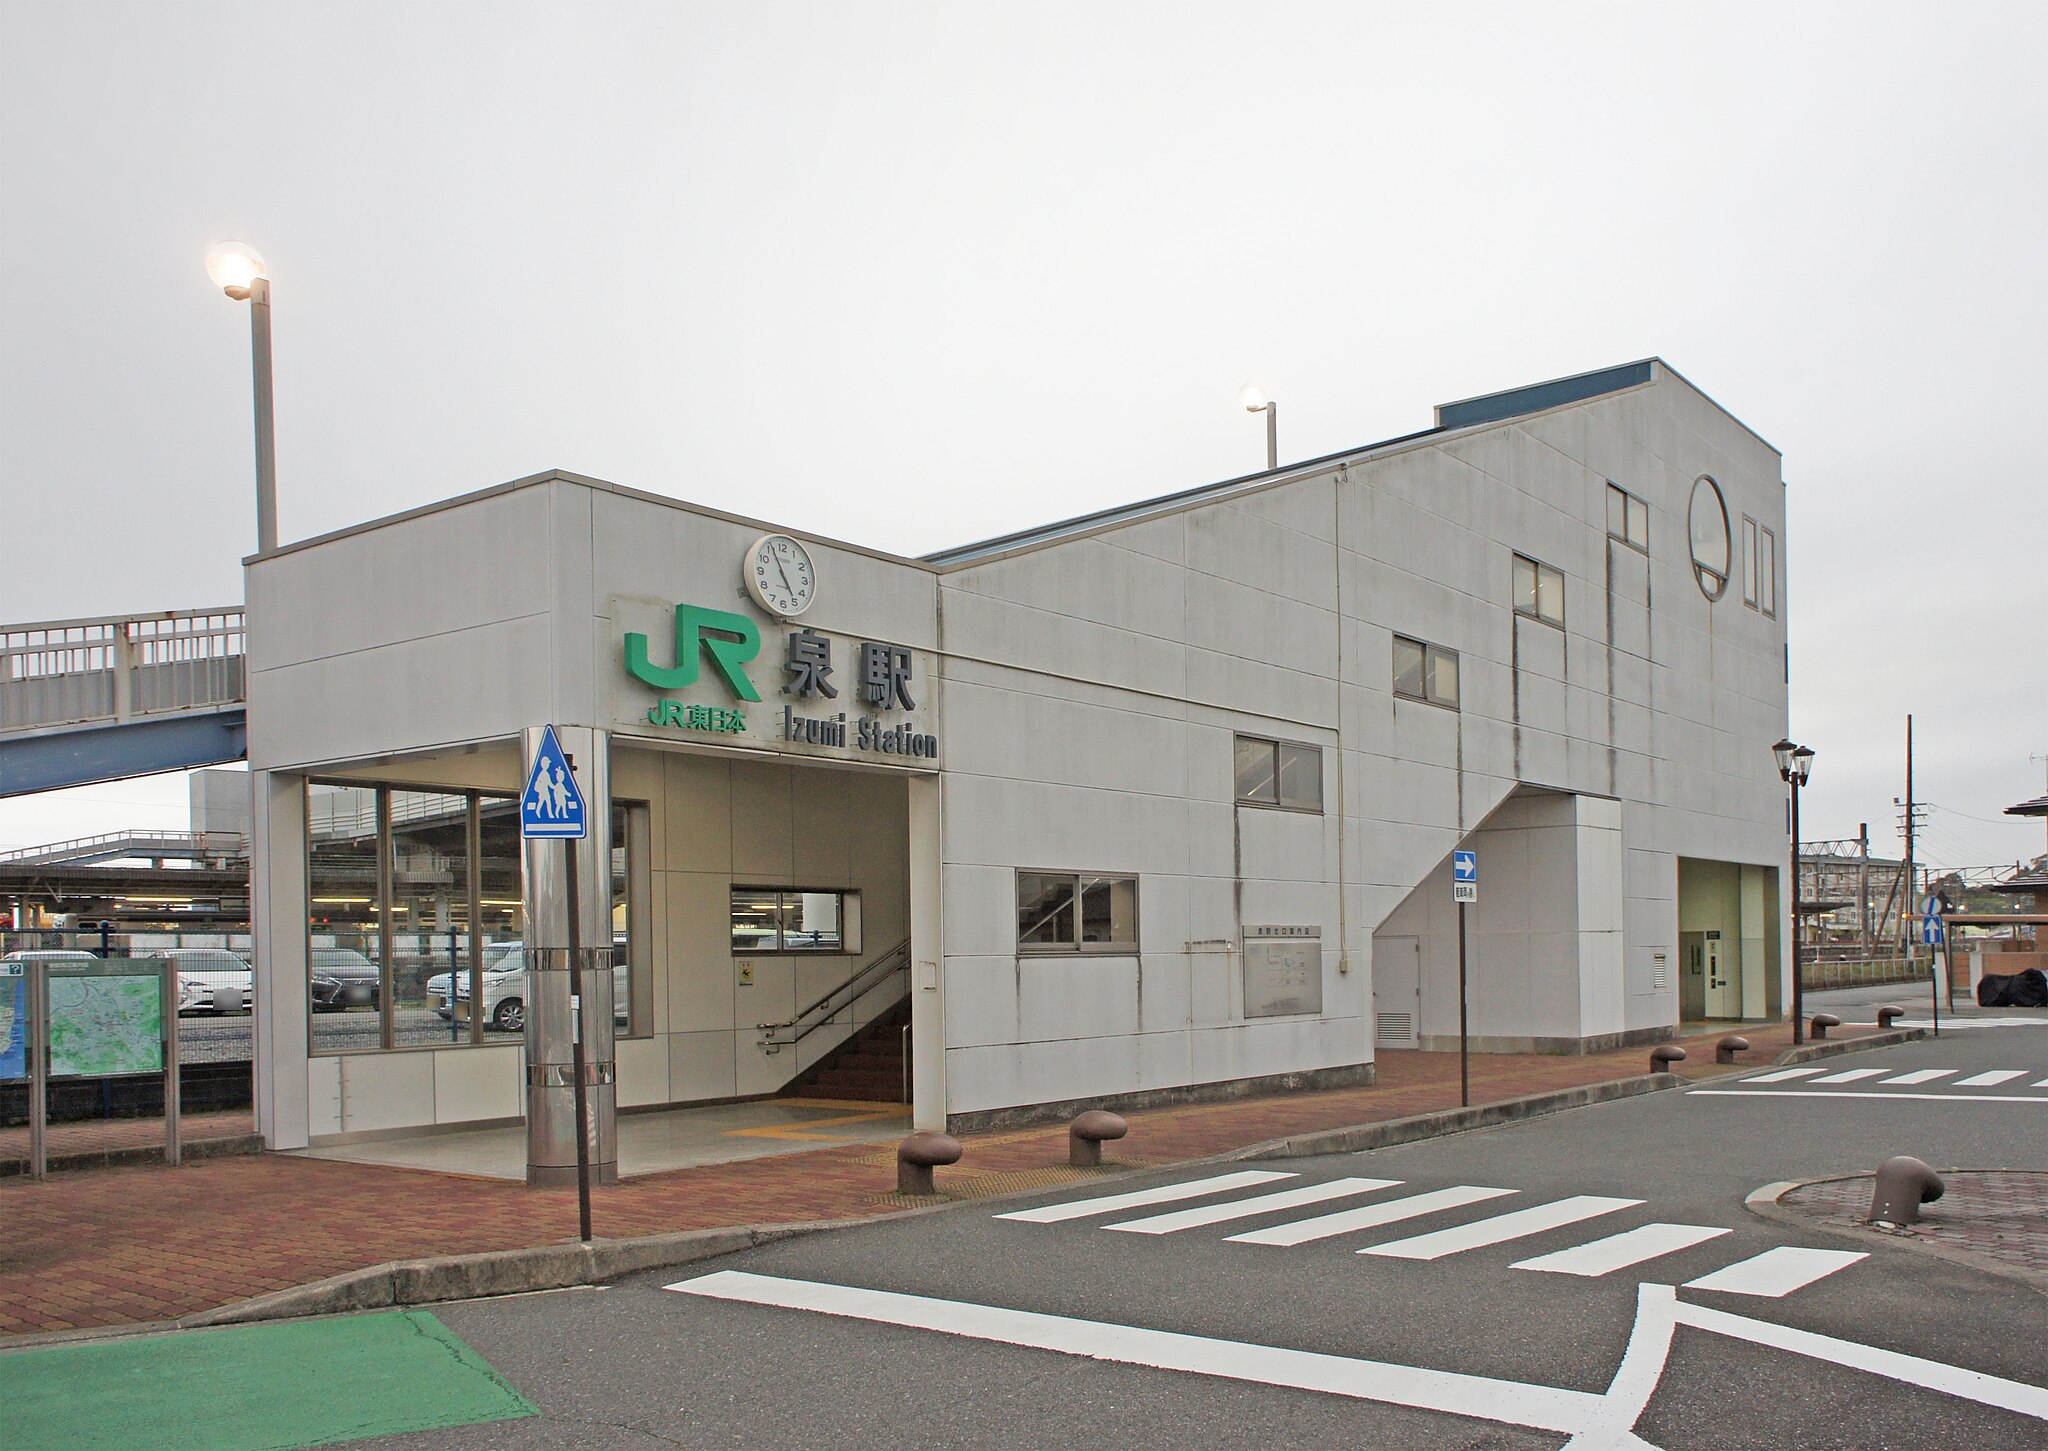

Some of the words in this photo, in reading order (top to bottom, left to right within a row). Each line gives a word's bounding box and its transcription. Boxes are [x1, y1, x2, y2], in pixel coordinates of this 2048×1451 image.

[778, 543, 787, 553] 12
[759, 554, 770, 564] 10
[757, 566, 765, 576] 9
[798, 562, 805, 571] 2
[760, 580, 768, 590] 8
[801, 576, 808, 586] 3
[769, 593, 776, 602] 7
[798, 589, 806, 598] 4
[780, 600, 787, 609] 6
[791, 597, 798, 607] 5
[624, 603, 762, 702] JR
[782, 628, 916, 712] 泉駅
[647, 699, 748, 734] JR東日本
[784, 704, 846, 748] Izumi
[857, 716, 938, 758] Station
